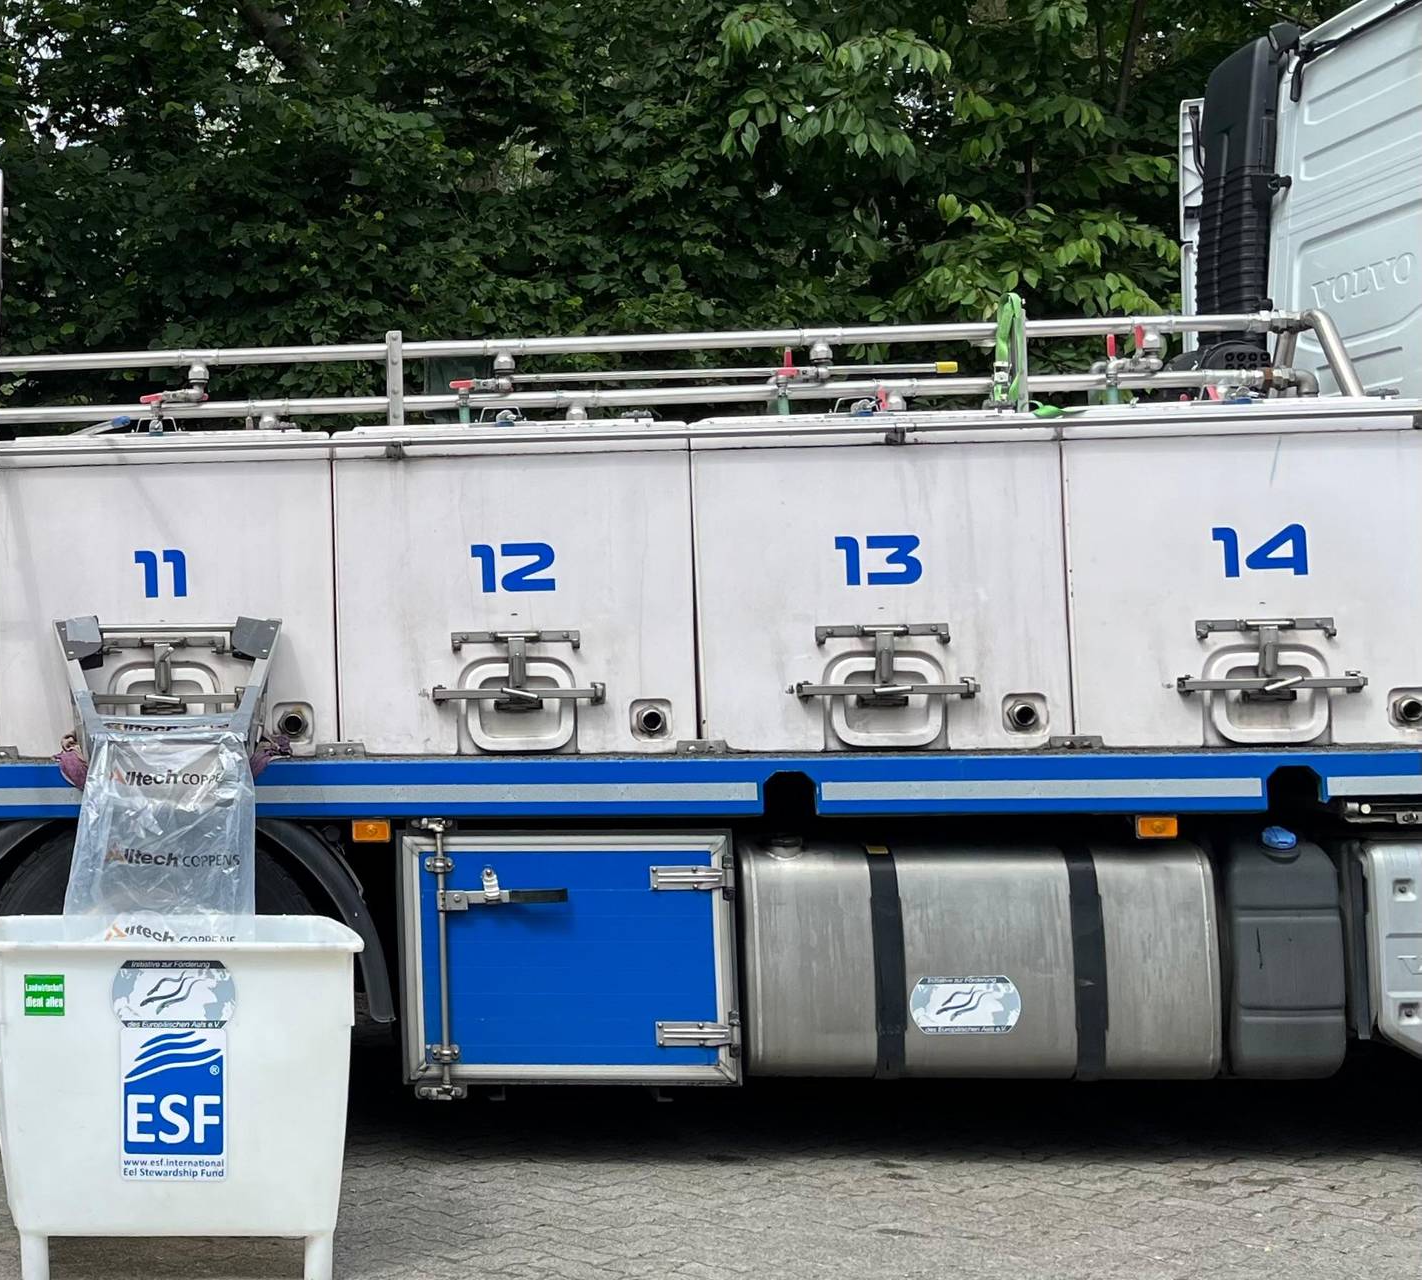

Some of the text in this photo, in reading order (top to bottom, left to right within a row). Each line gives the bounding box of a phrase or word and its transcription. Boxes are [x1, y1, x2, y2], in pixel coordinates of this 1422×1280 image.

[1311, 252, 1416, 309] VOLVO
[134, 549, 187, 598] 11
[471, 543, 556, 592] 12
[835, 535, 922, 586] 13
[1213, 524, 1308, 578] 14
[105, 841, 241, 868] Alltech COPPENS
[127, 1094, 221, 1144] ESF
[123, 1159, 224, 1168] www.esf.international
[123, 1168, 224, 1179] Eel Stewardship Fund
